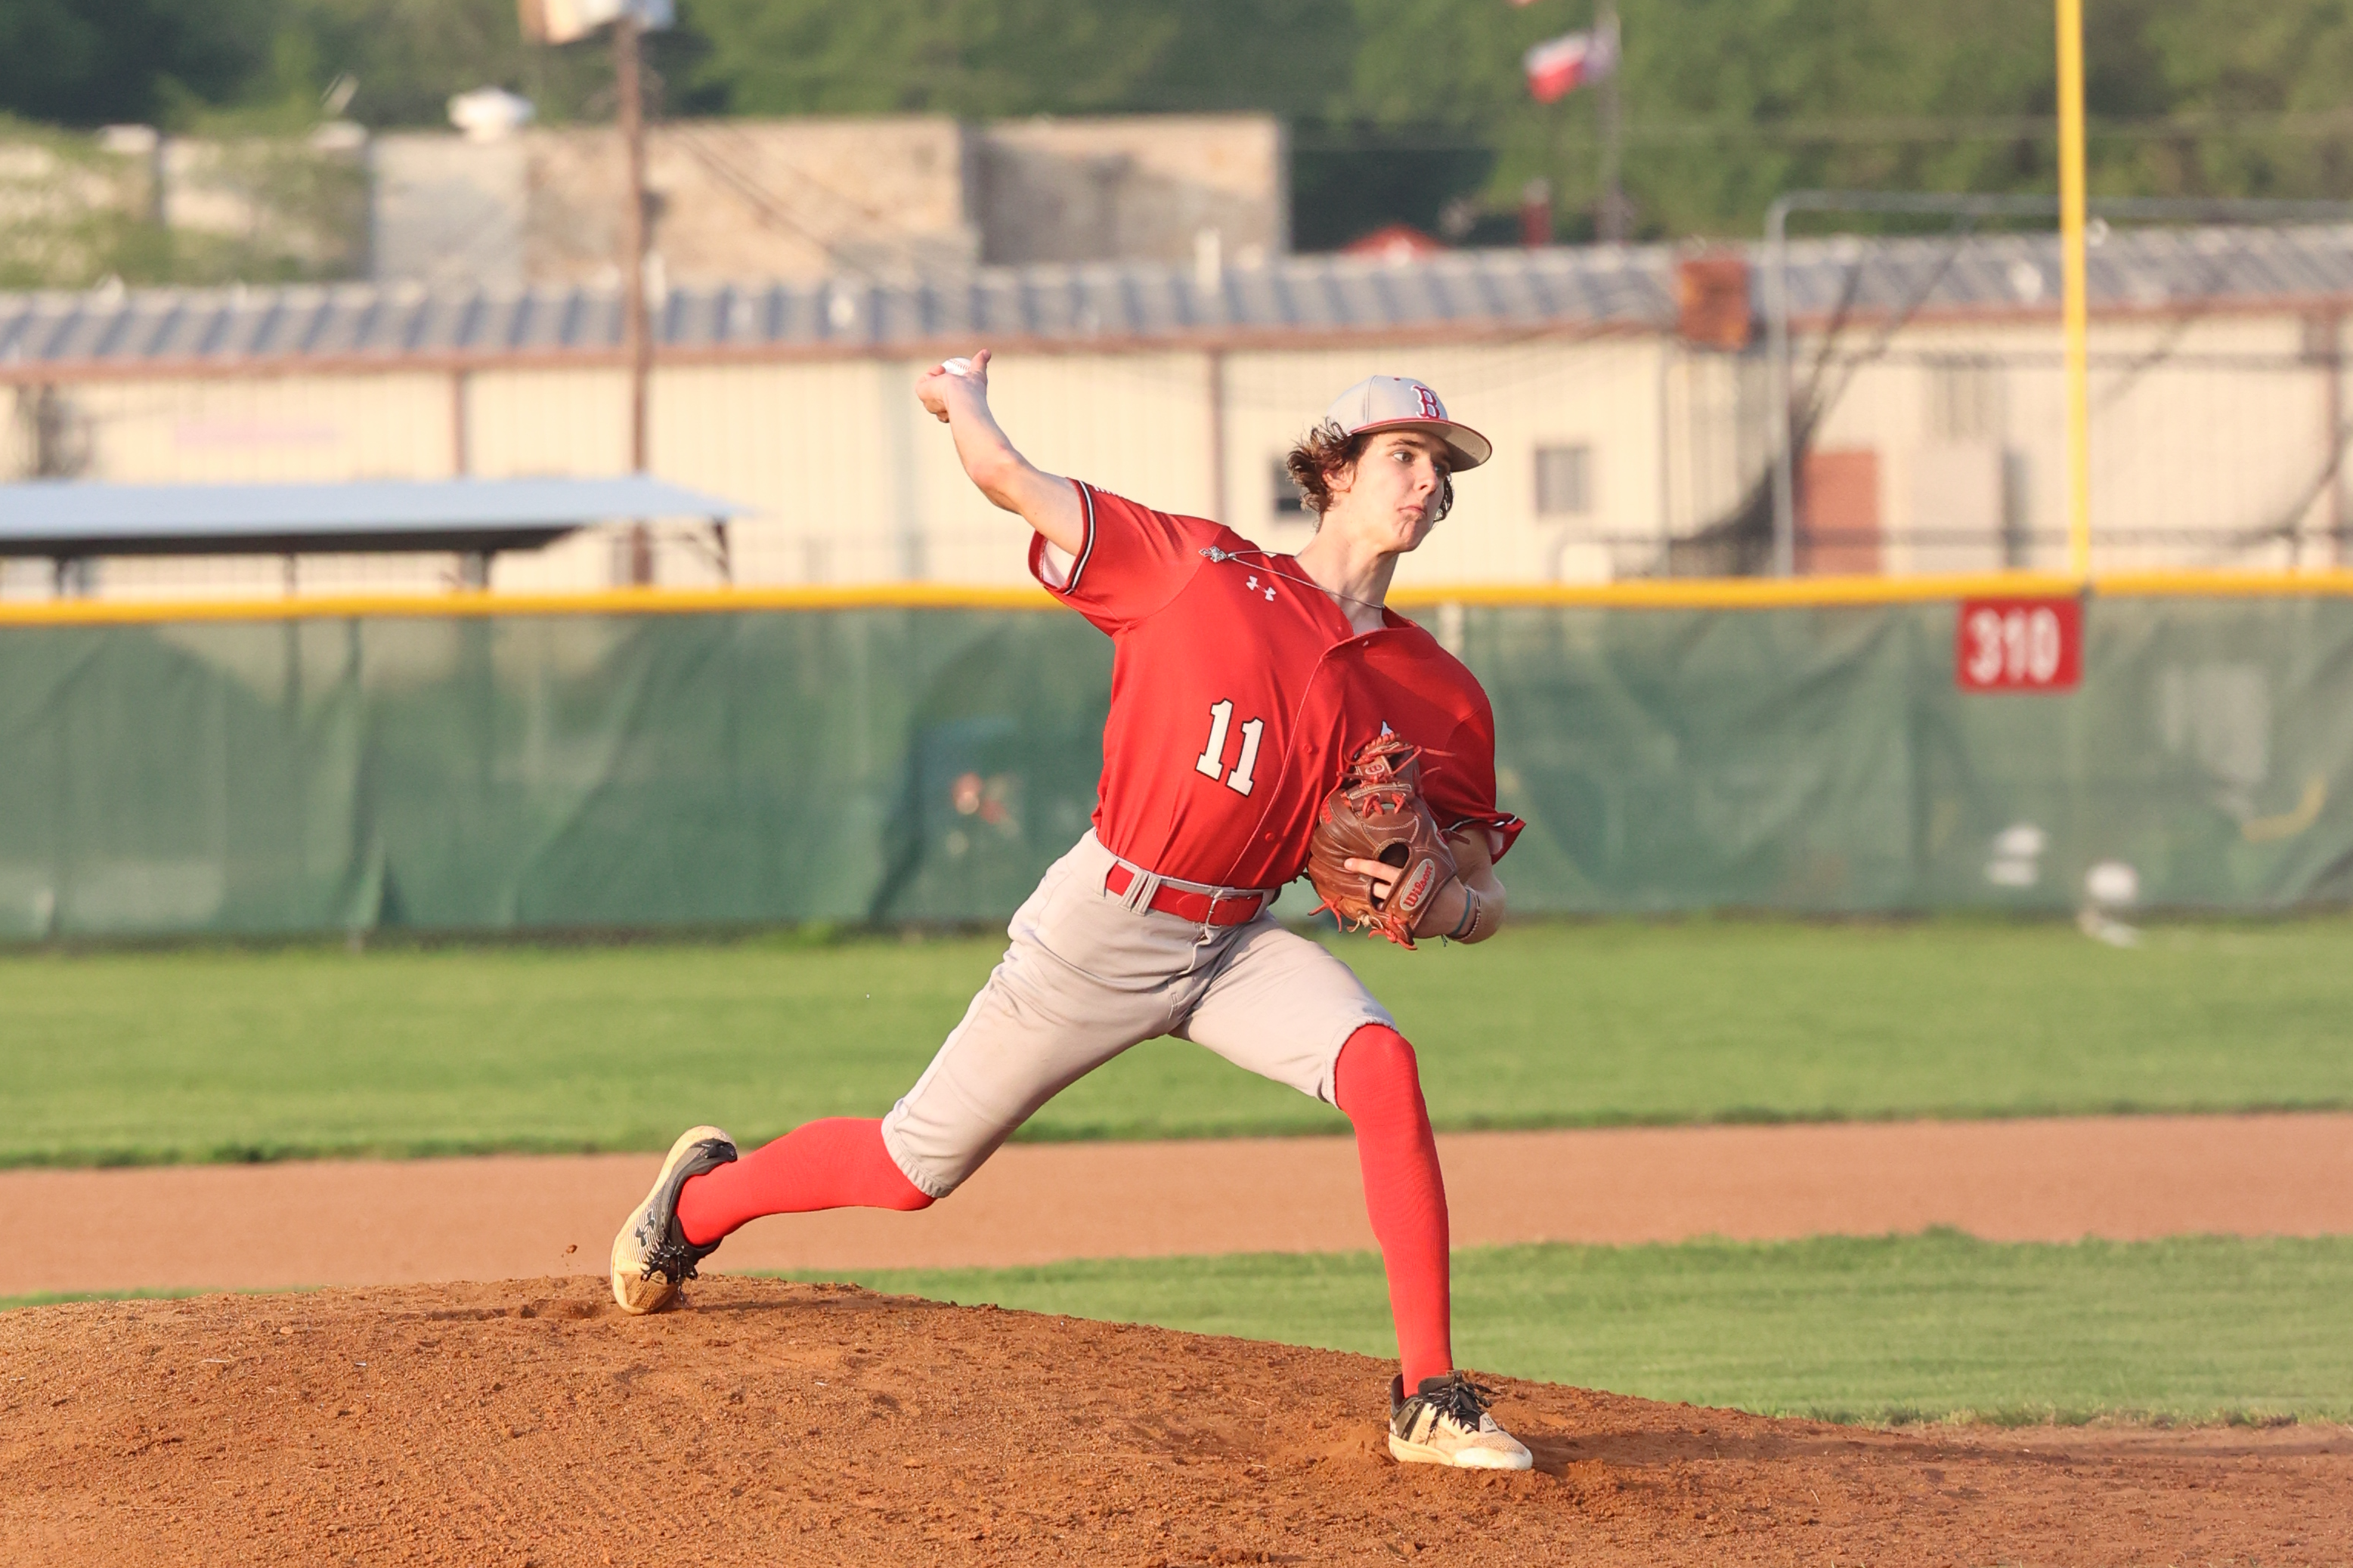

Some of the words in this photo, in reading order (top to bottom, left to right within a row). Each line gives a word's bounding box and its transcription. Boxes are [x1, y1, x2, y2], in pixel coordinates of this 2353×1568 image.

[1410, 385, 1441, 419] B
[1968, 607, 2061, 683] 310
[1195, 697, 1265, 797] 11
[1404, 862, 1433, 907] Wilson
